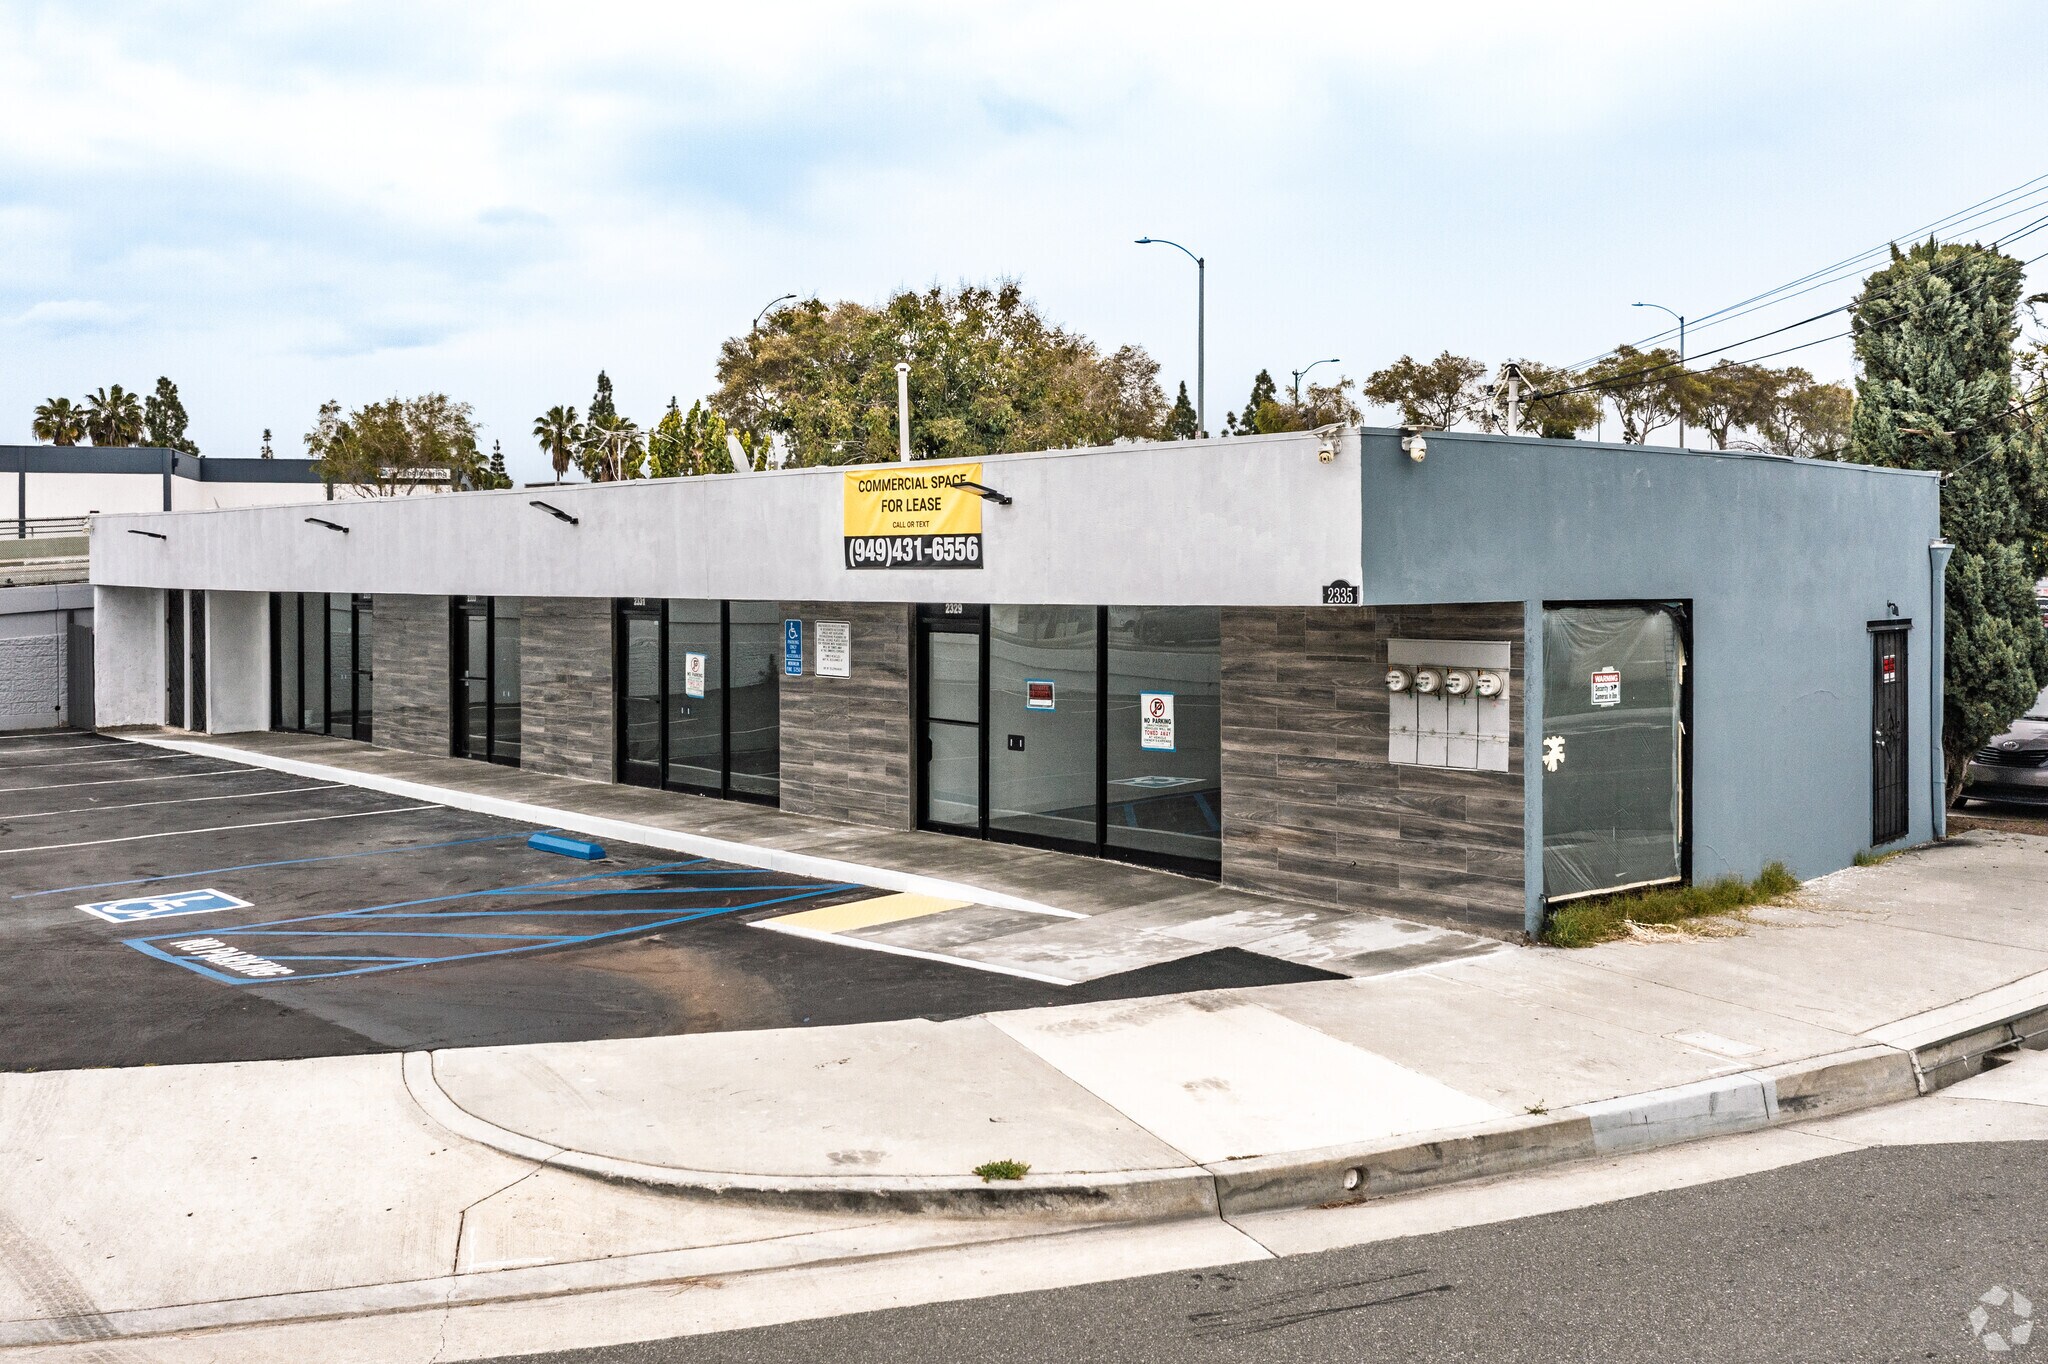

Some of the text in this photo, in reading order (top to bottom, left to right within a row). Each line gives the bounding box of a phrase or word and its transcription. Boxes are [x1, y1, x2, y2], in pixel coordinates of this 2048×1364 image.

[859, 477, 928, 492] COMMERCIAL
[881, 497, 941, 512] FOR LEASE
[892, 521, 906, 529] CALL
[916, 520, 929, 528] TEXT
[849, 537, 978, 566] (949)431-6556
[1327, 587, 1354, 603] 2335
[945, 603, 963, 614] 2329
[1594, 674, 1619, 683] WARNING
[170, 937, 226, 951] NO
[191, 946, 296, 976] PARKING
